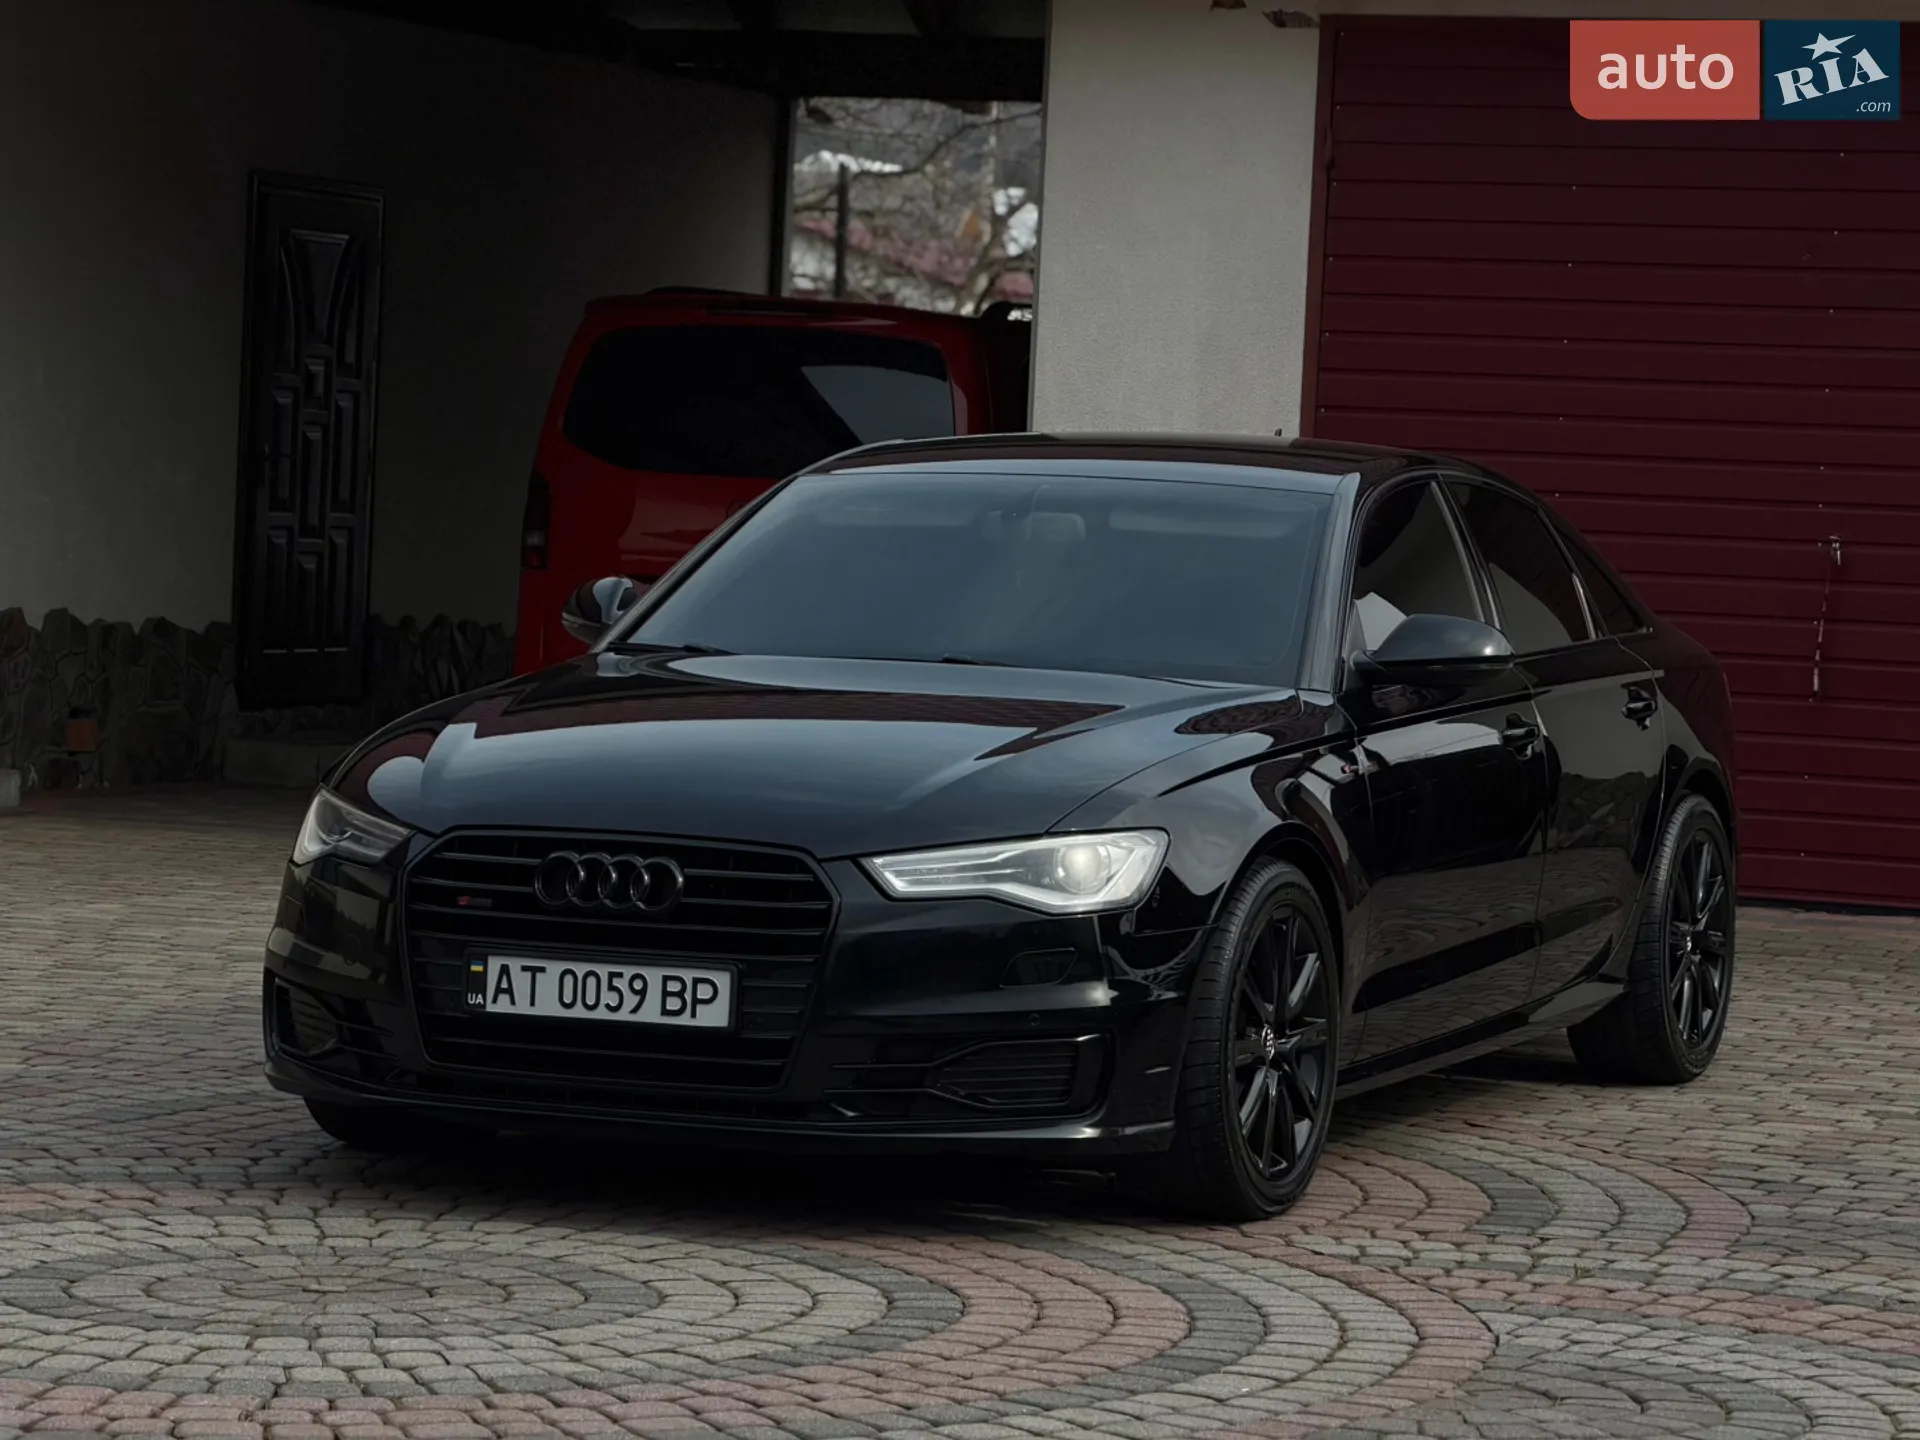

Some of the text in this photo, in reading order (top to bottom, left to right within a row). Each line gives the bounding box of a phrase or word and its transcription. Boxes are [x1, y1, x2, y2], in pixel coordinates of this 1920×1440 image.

[467, 991, 484, 1004] UA
[491, 963, 719, 1019] AT 0059 BP
